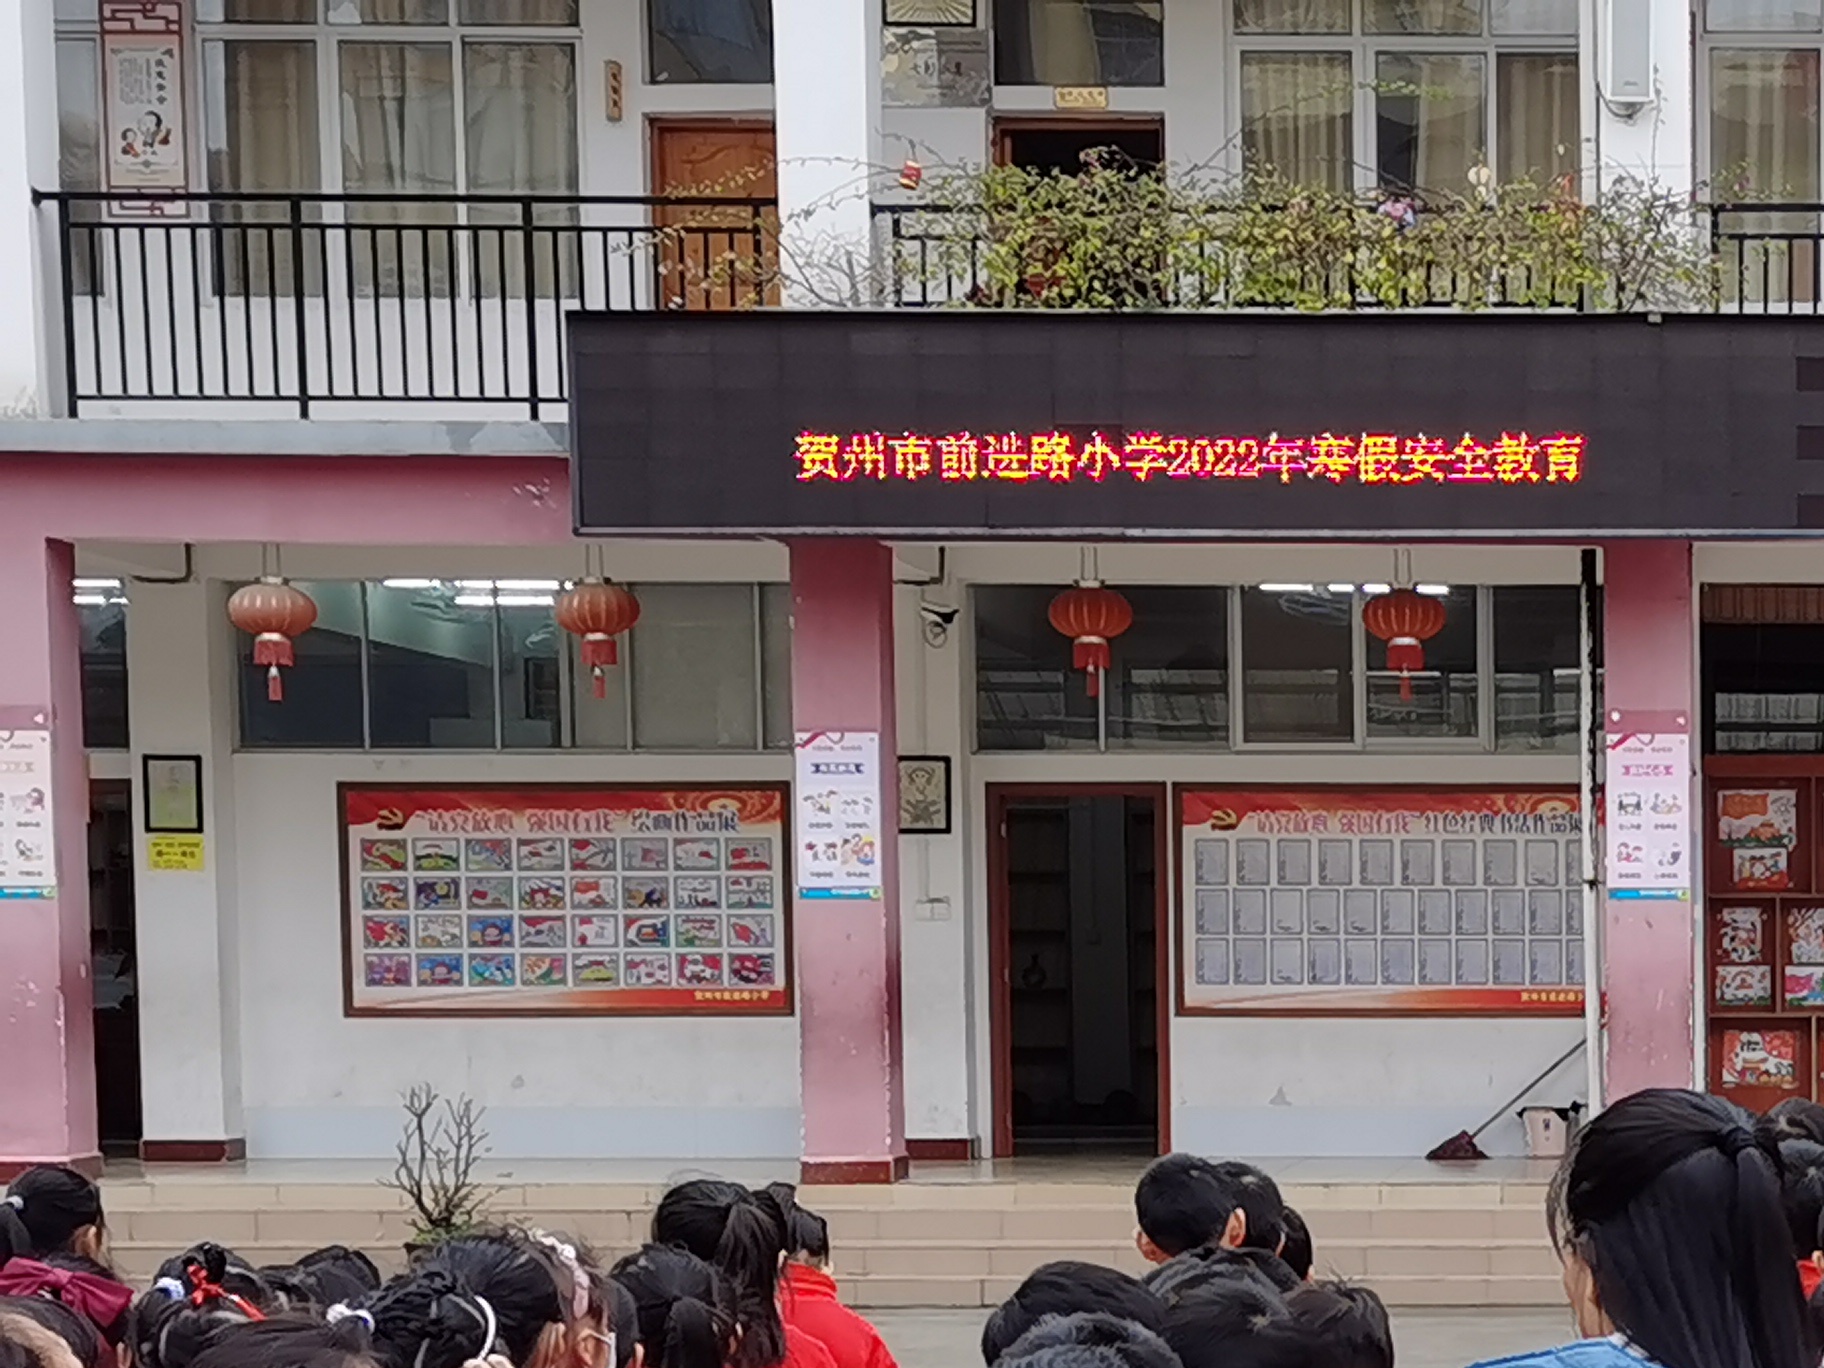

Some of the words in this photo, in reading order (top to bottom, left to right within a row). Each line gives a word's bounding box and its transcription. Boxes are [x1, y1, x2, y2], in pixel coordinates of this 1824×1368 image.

[793, 431, 1588, 483] 贺州市前进路小学2022年寒假安全教育
